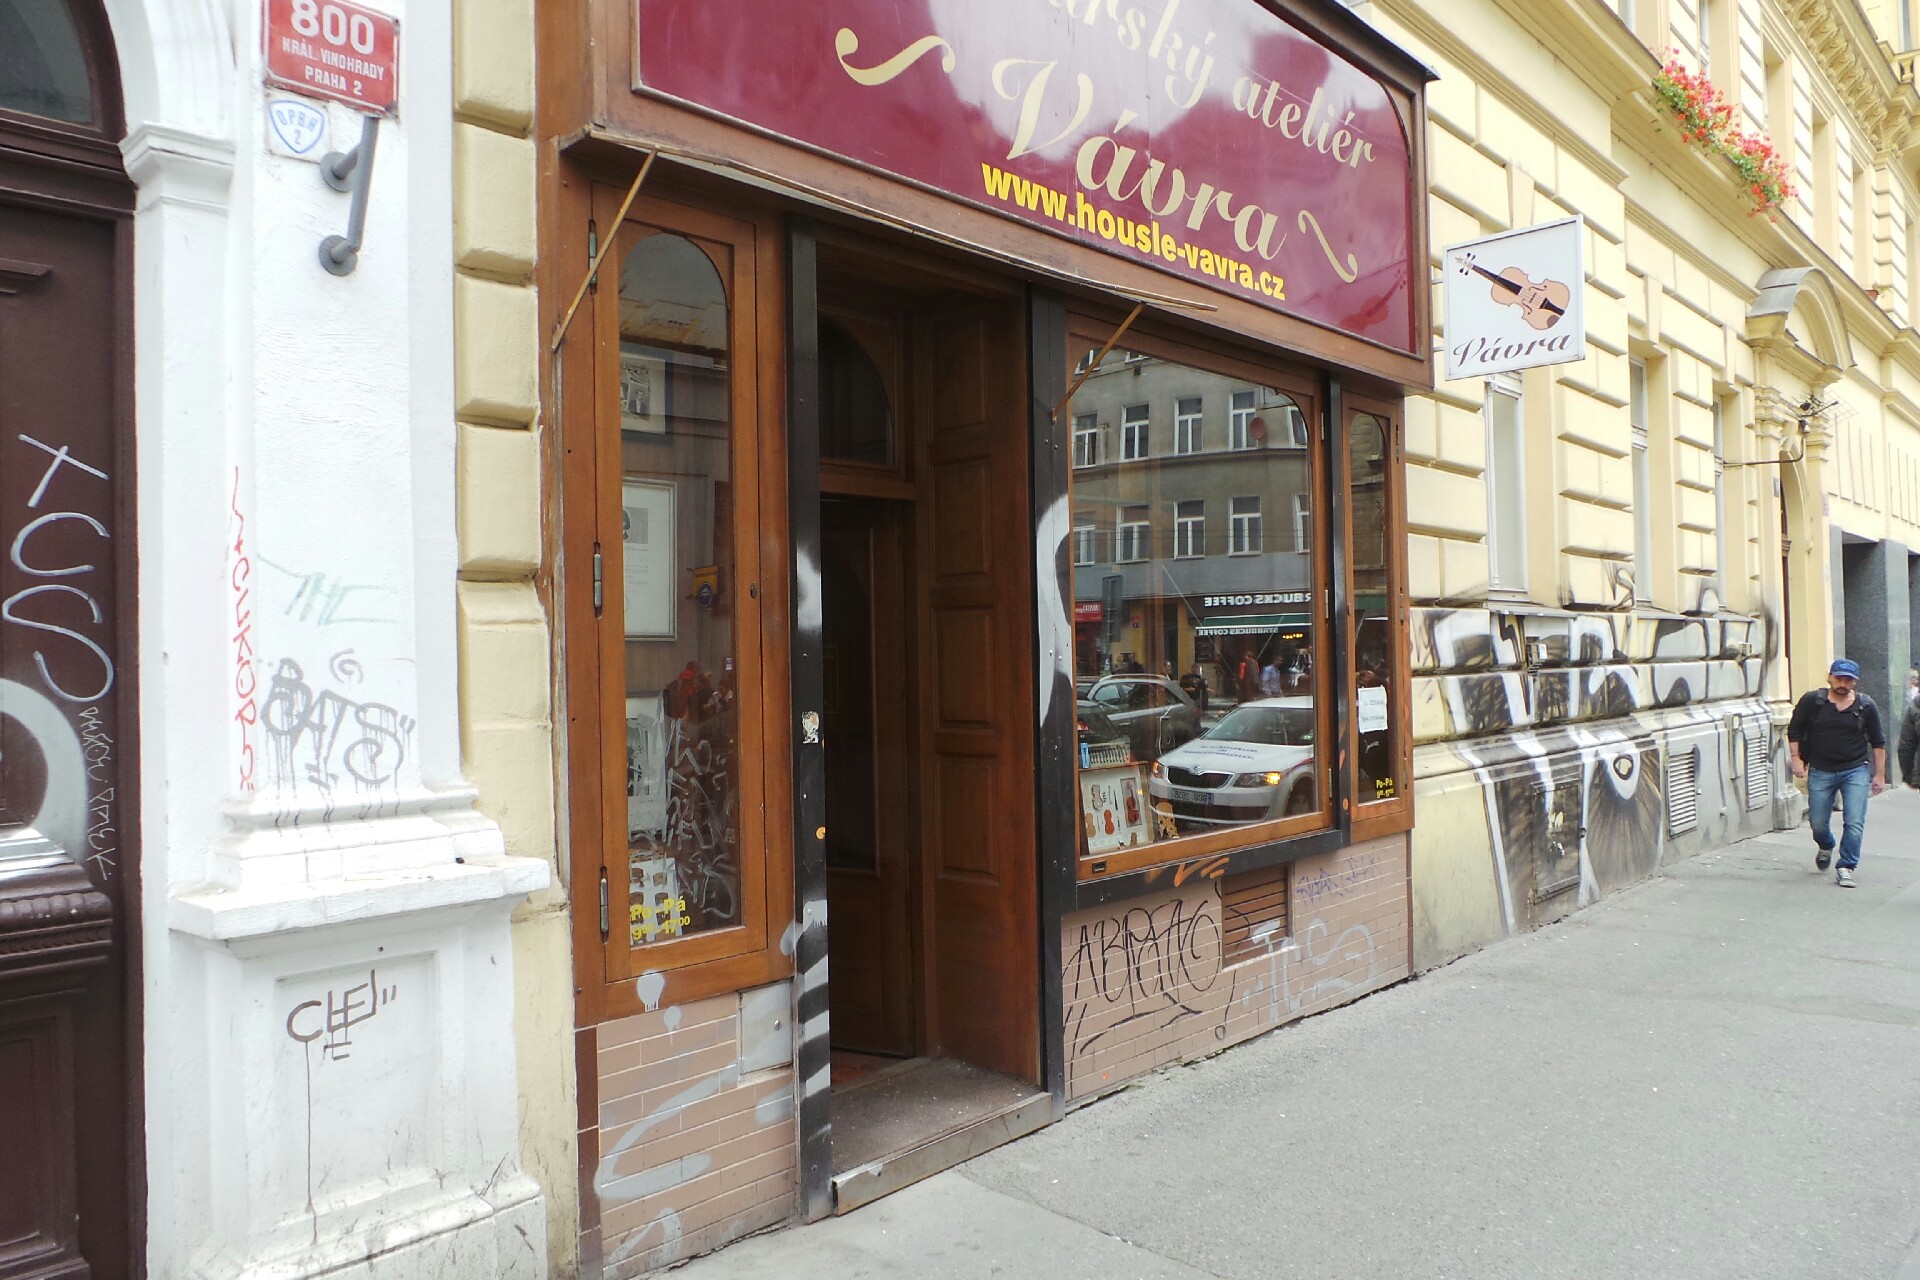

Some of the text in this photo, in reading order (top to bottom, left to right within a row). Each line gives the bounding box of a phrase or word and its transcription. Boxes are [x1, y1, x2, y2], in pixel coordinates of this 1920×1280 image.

[290, 0, 374, 54] 800
[305, 65, 363, 95] PRAHA 2
[320, 48, 384, 80] VINOHRADY
[1232, 74, 1376, 168] ateliér
[991, 57, 1287, 260] Vávra
[982, 163, 1285, 300] www.housle-vavra.cz
[1453, 334, 1574, 367] Vávra
